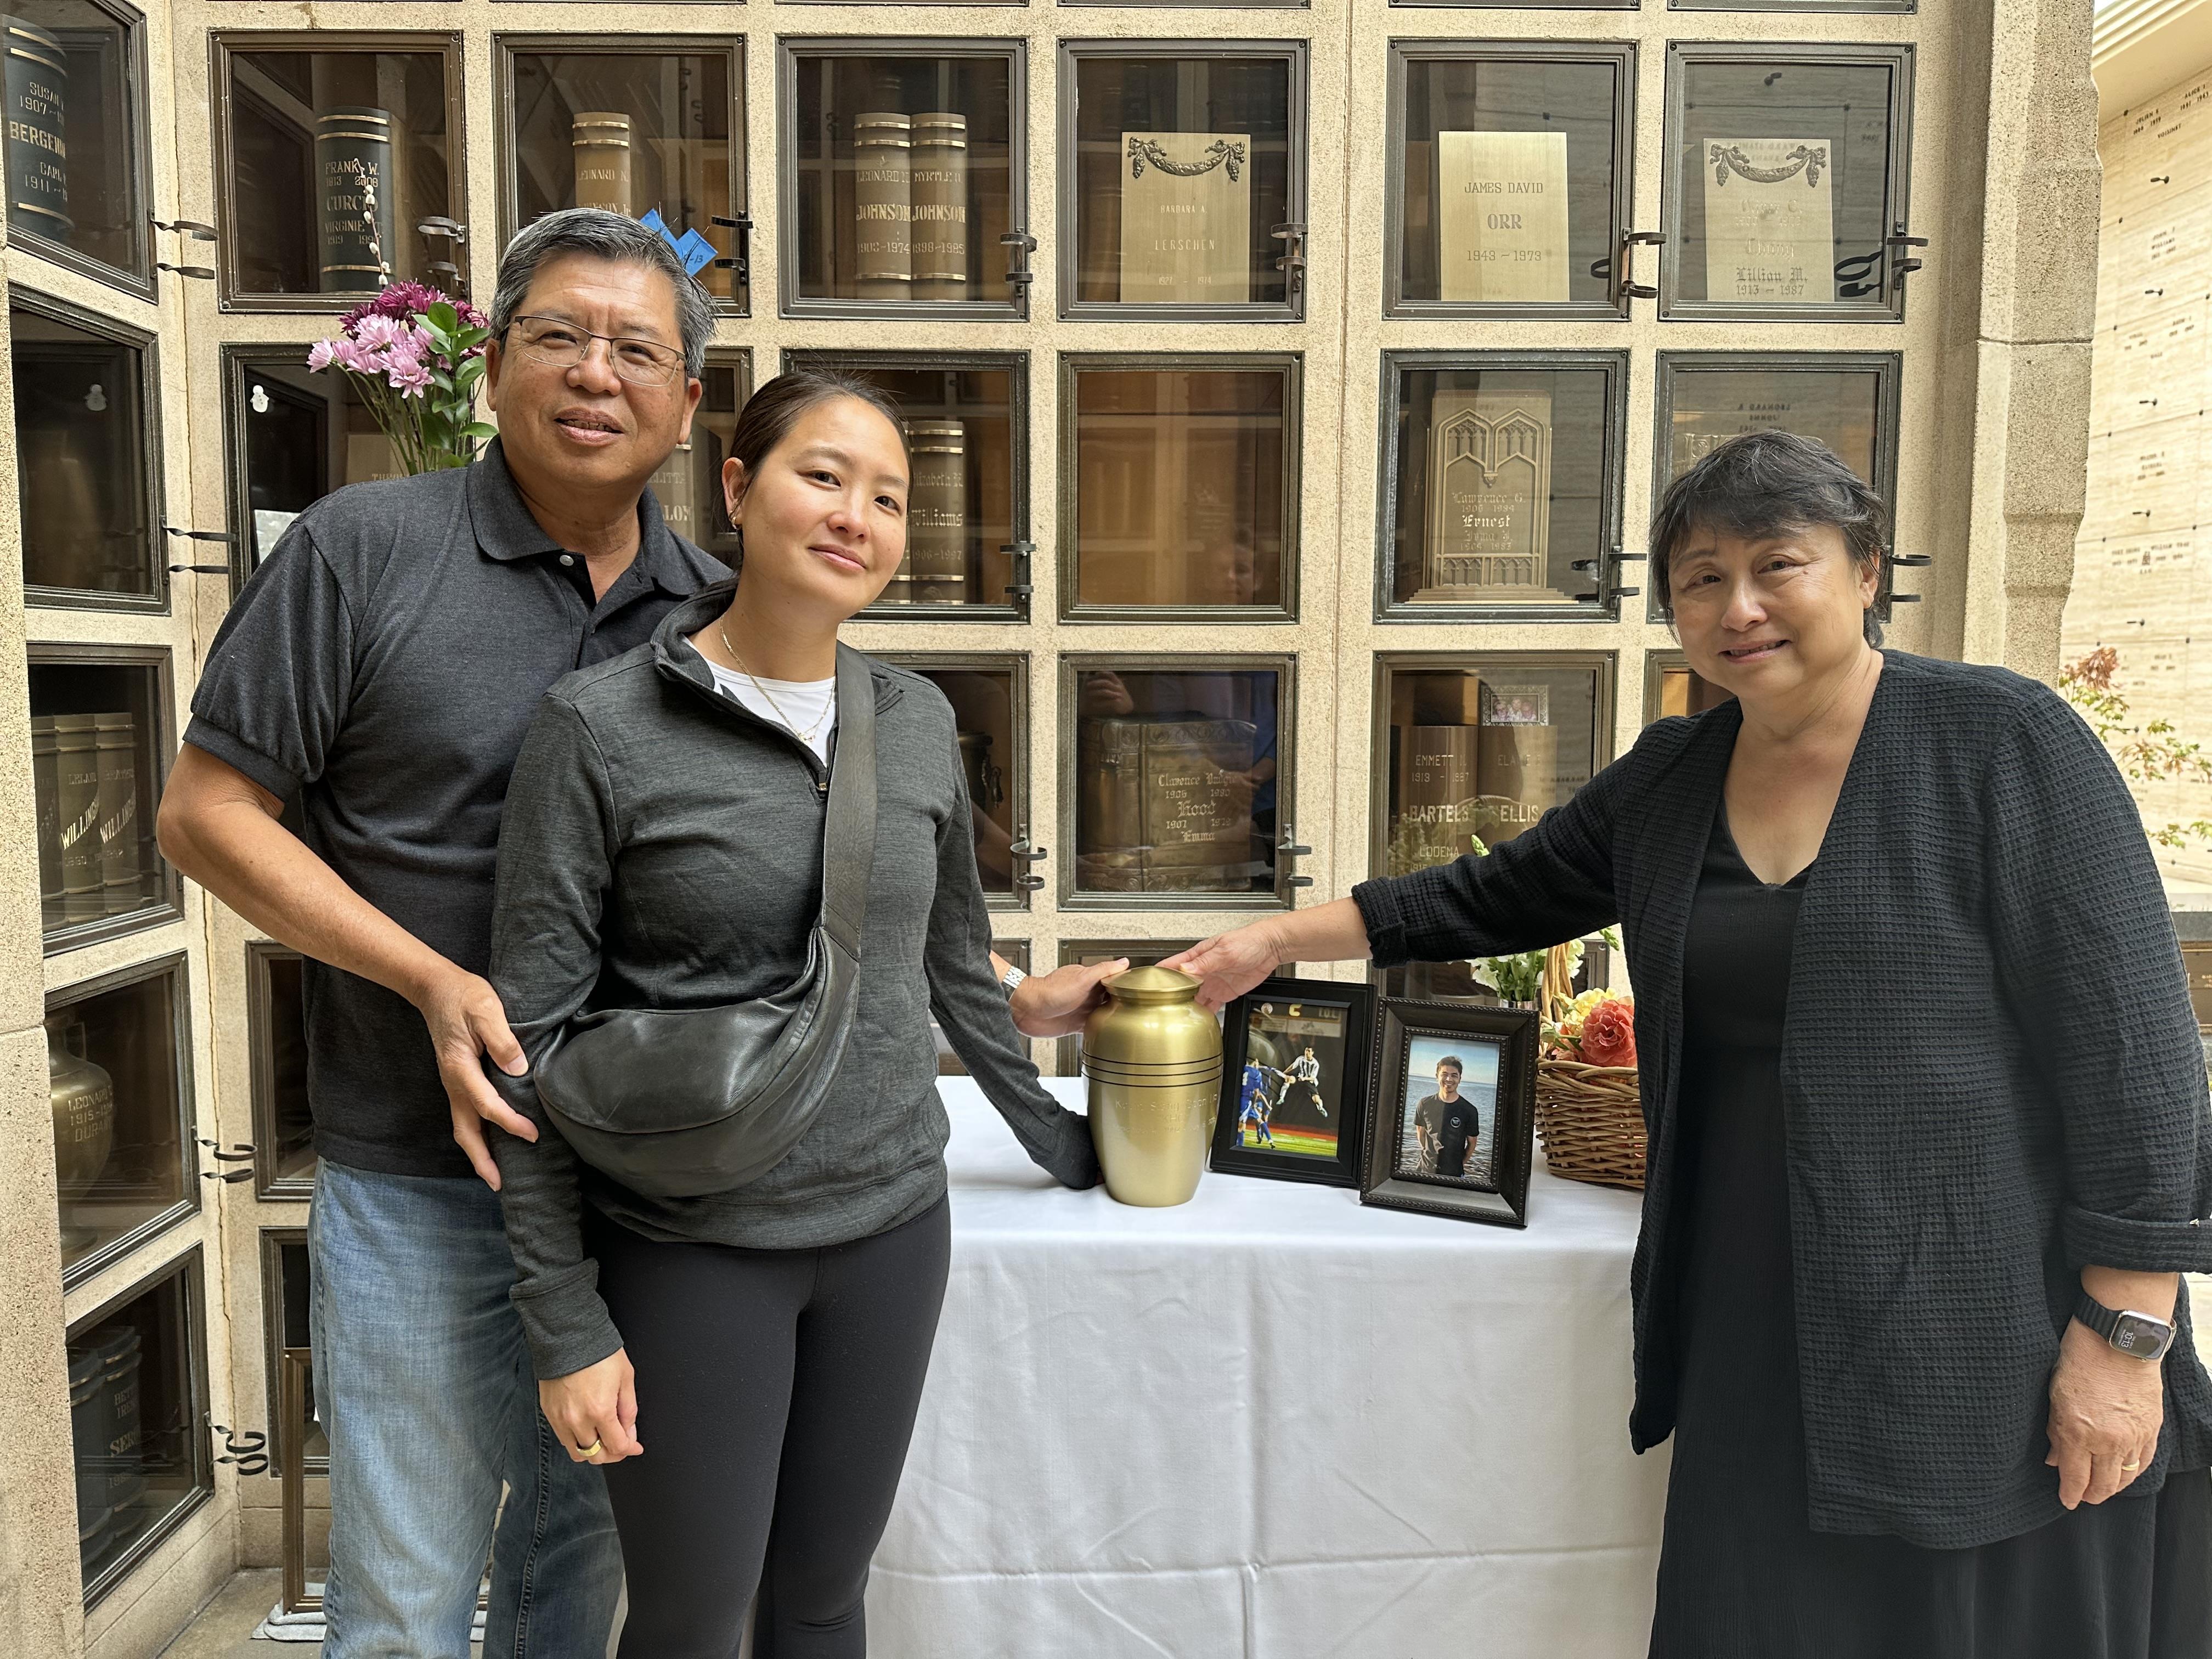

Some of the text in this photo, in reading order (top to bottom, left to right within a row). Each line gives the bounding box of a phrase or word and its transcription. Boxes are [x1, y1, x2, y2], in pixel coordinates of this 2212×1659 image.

[20, 95, 47, 115] 1907
[40, 162, 62, 183] CARL
[325, 160, 360, 175] FRANK
[25, 174, 49, 193] 1911
[857, 170, 899, 183] LEONARD
[1464, 182, 1543, 193] JAMES DAVID
[856, 204, 911, 222] JOHNSON
[912, 205, 966, 224] JOHNSON
[1160, 205, 1195, 214] BARBARA
[1487, 213, 1522, 229] ORR
[1155, 239, 1215, 251] LERSCHEN
[1467, 250, 1496, 261] 1943
[1514, 250, 1542, 261] 1973
[1735, 267, 1808, 283] Lillian M.
[1736, 284, 1759, 295] 1913
[1780, 284, 1804, 295] 1987
[1452, 492, 1508, 505] Lawrence
[1462, 514, 1511, 528] Ernest
[1415, 754, 1454, 766] EMMETT
[1158, 772, 1200, 787] Clarence
[1177, 799, 1216, 818] Hood
[1409, 805, 1469, 822] BARTELS
[1500, 805, 1539, 822] ELLIS
[1181, 830, 1216, 842] Emma
[1420, 846, 1459, 858] LODEMA
[69, 1088, 108, 1112] LEONARD
